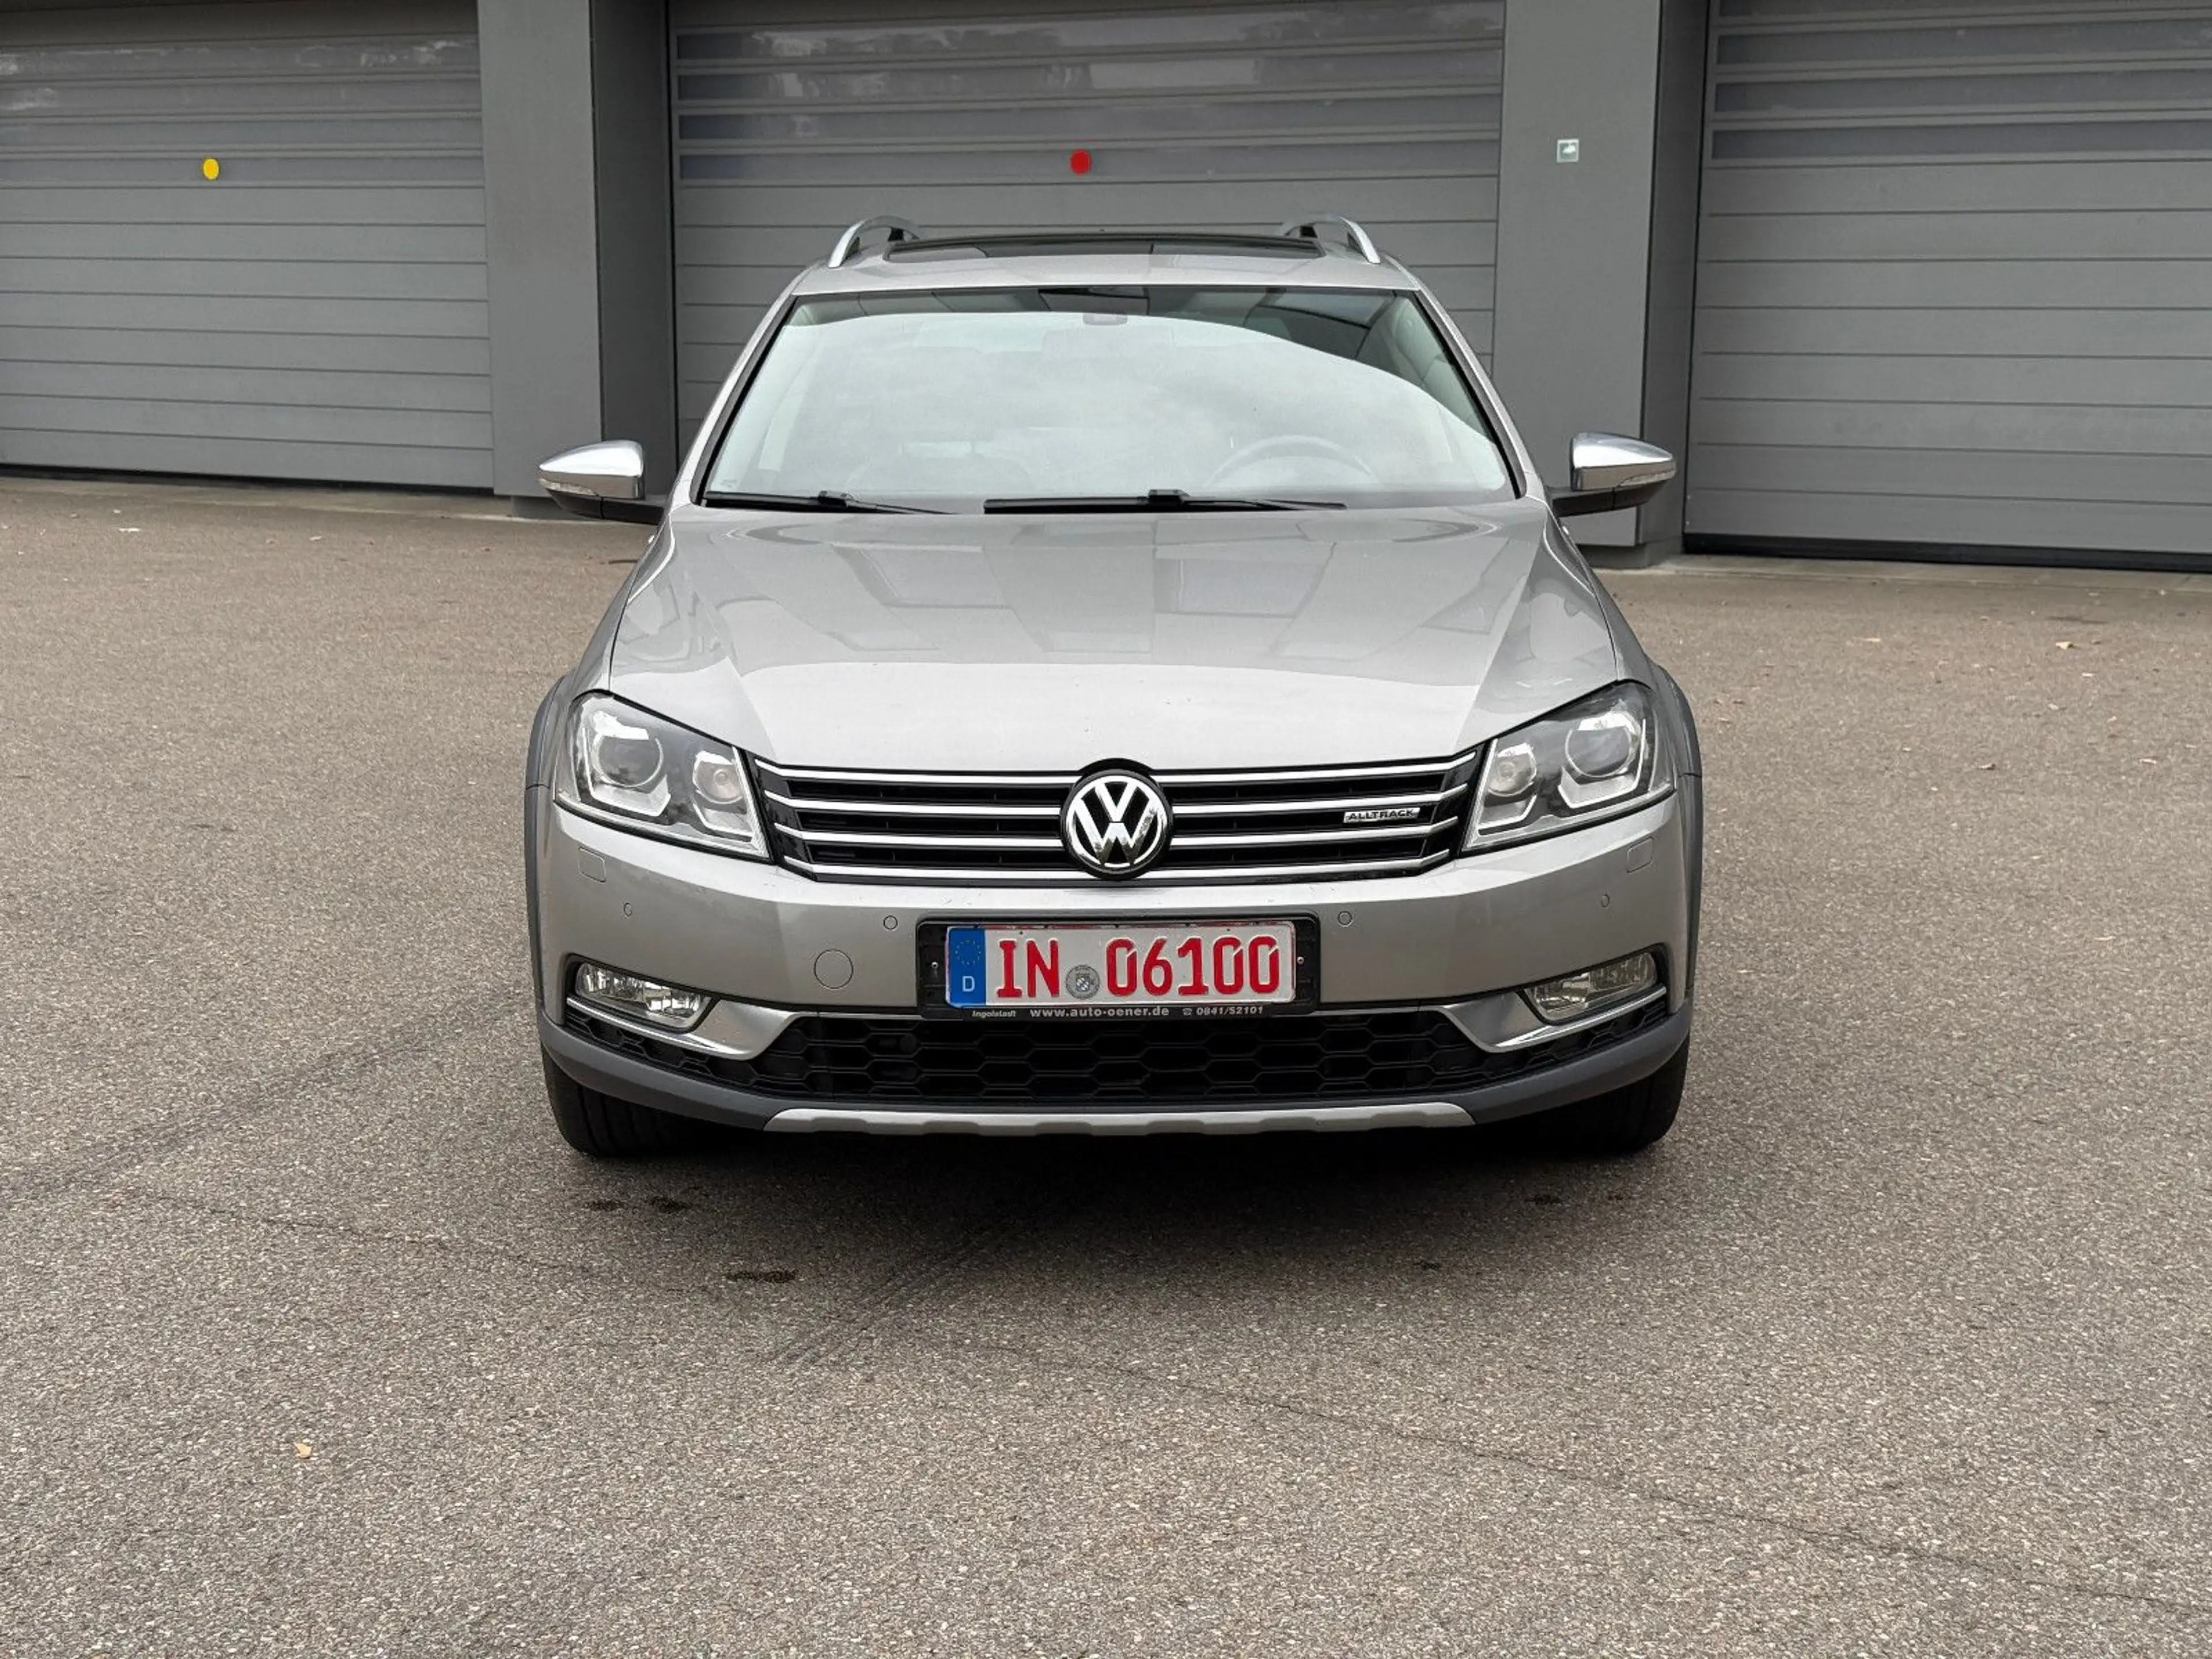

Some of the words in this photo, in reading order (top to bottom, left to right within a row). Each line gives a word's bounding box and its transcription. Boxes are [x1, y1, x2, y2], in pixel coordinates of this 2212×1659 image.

[1069, 777, 1166, 866] VW
[1348, 809, 1414, 820] ALLTRACK
[997, 939, 1059, 998] IN
[1105, 935, 1279, 997] 06100
[962, 975, 975, 992] D
[1196, 1006, 1263, 1016] 0841/52101
